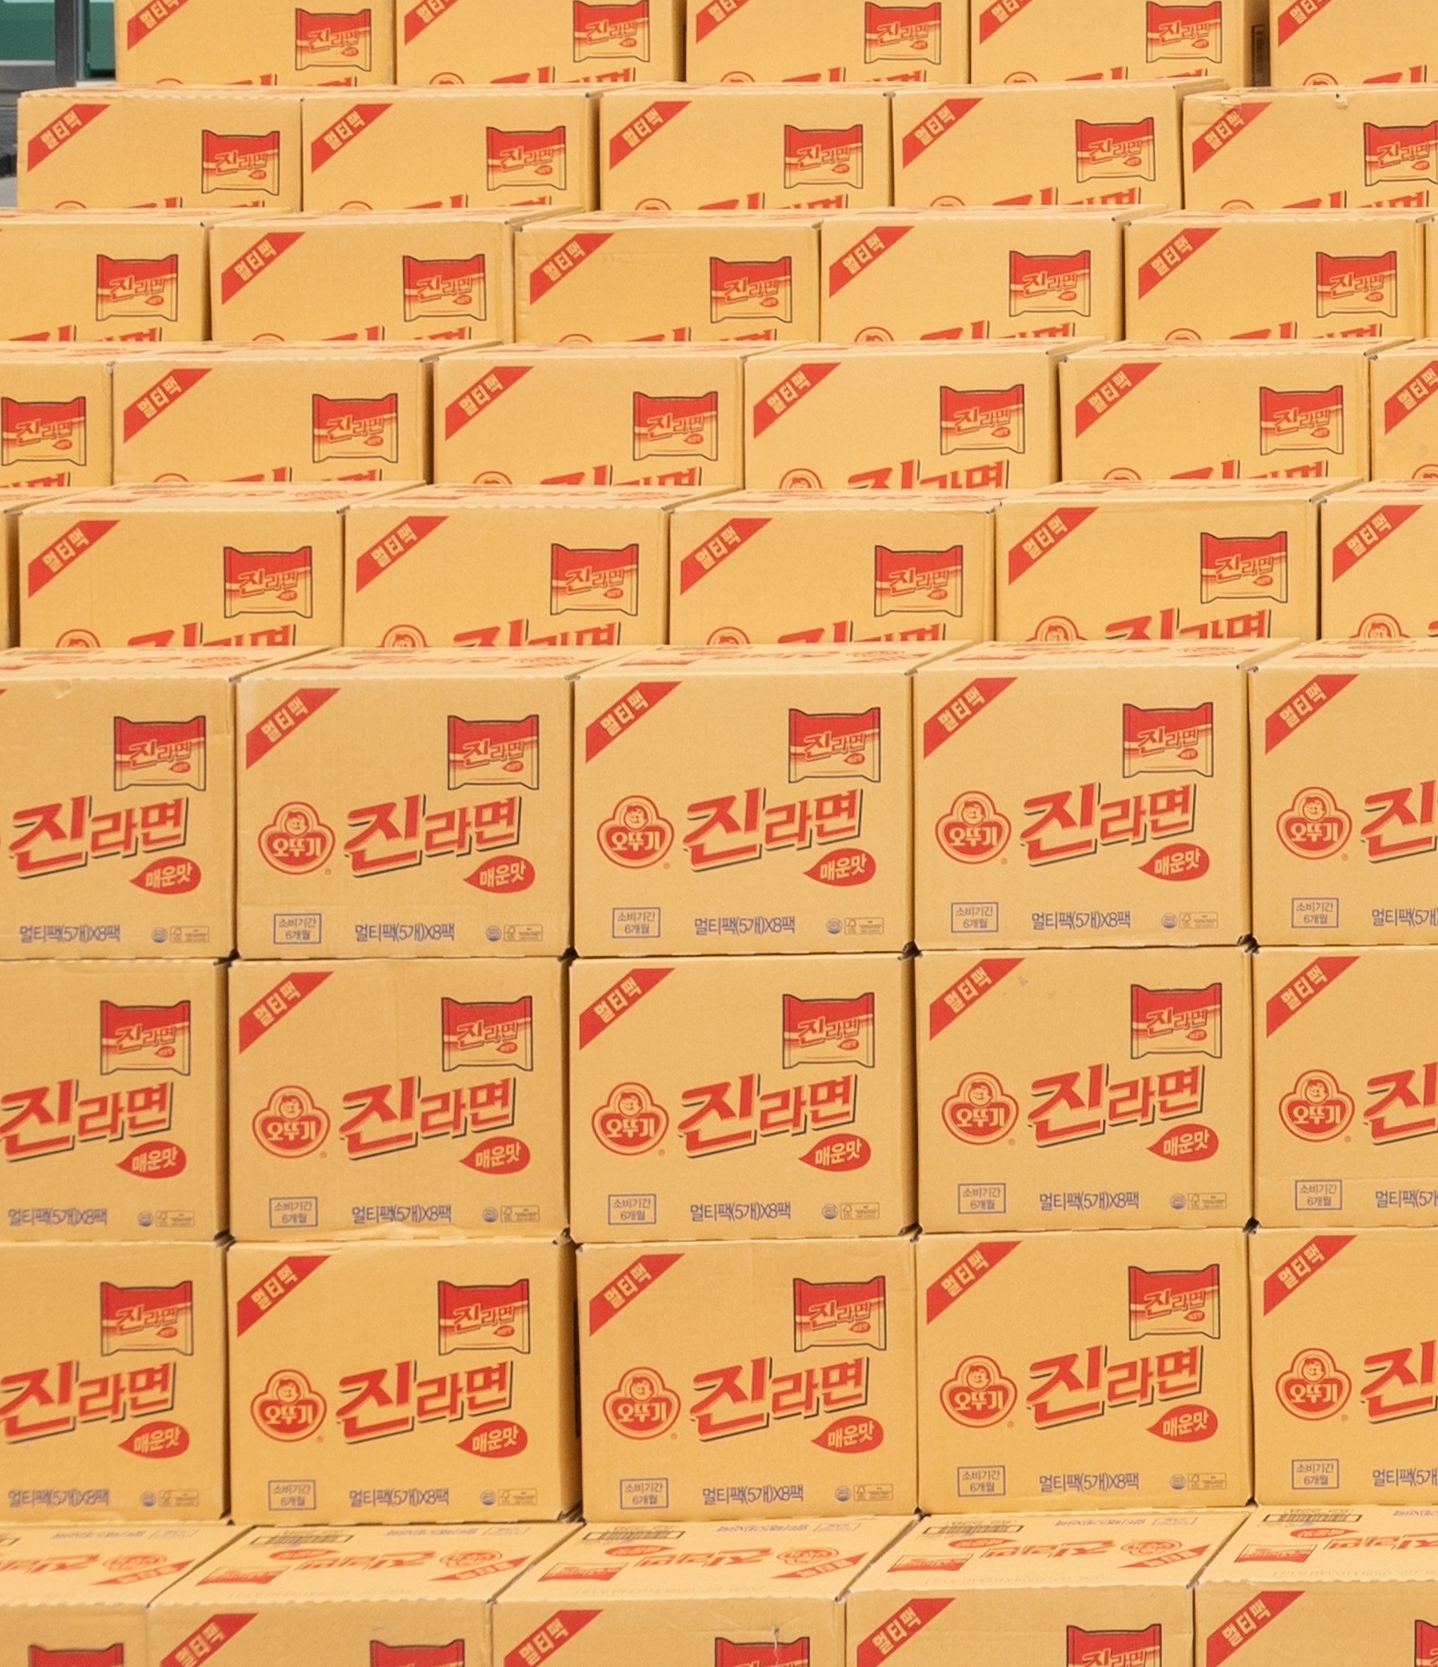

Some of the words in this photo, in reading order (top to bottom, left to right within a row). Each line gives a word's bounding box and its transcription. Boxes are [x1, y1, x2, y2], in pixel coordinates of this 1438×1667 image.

[344, 794, 519, 878] 진라면
[1020, 783, 1194, 867] 진라면
[678, 1074, 855, 1157] 진라면
[1293, 1106, 1341, 1125] 오뚜기
[476, 1142, 521, 1169] 매운맛
[604, 1262, 652, 1309] 멀티팩
[809, 1300, 871, 1328] 진라면
[617, 1403, 667, 1422] 오뚜기
[690, 1357, 867, 1440] 진라면
[828, 1421, 874, 1448] 매운맛
